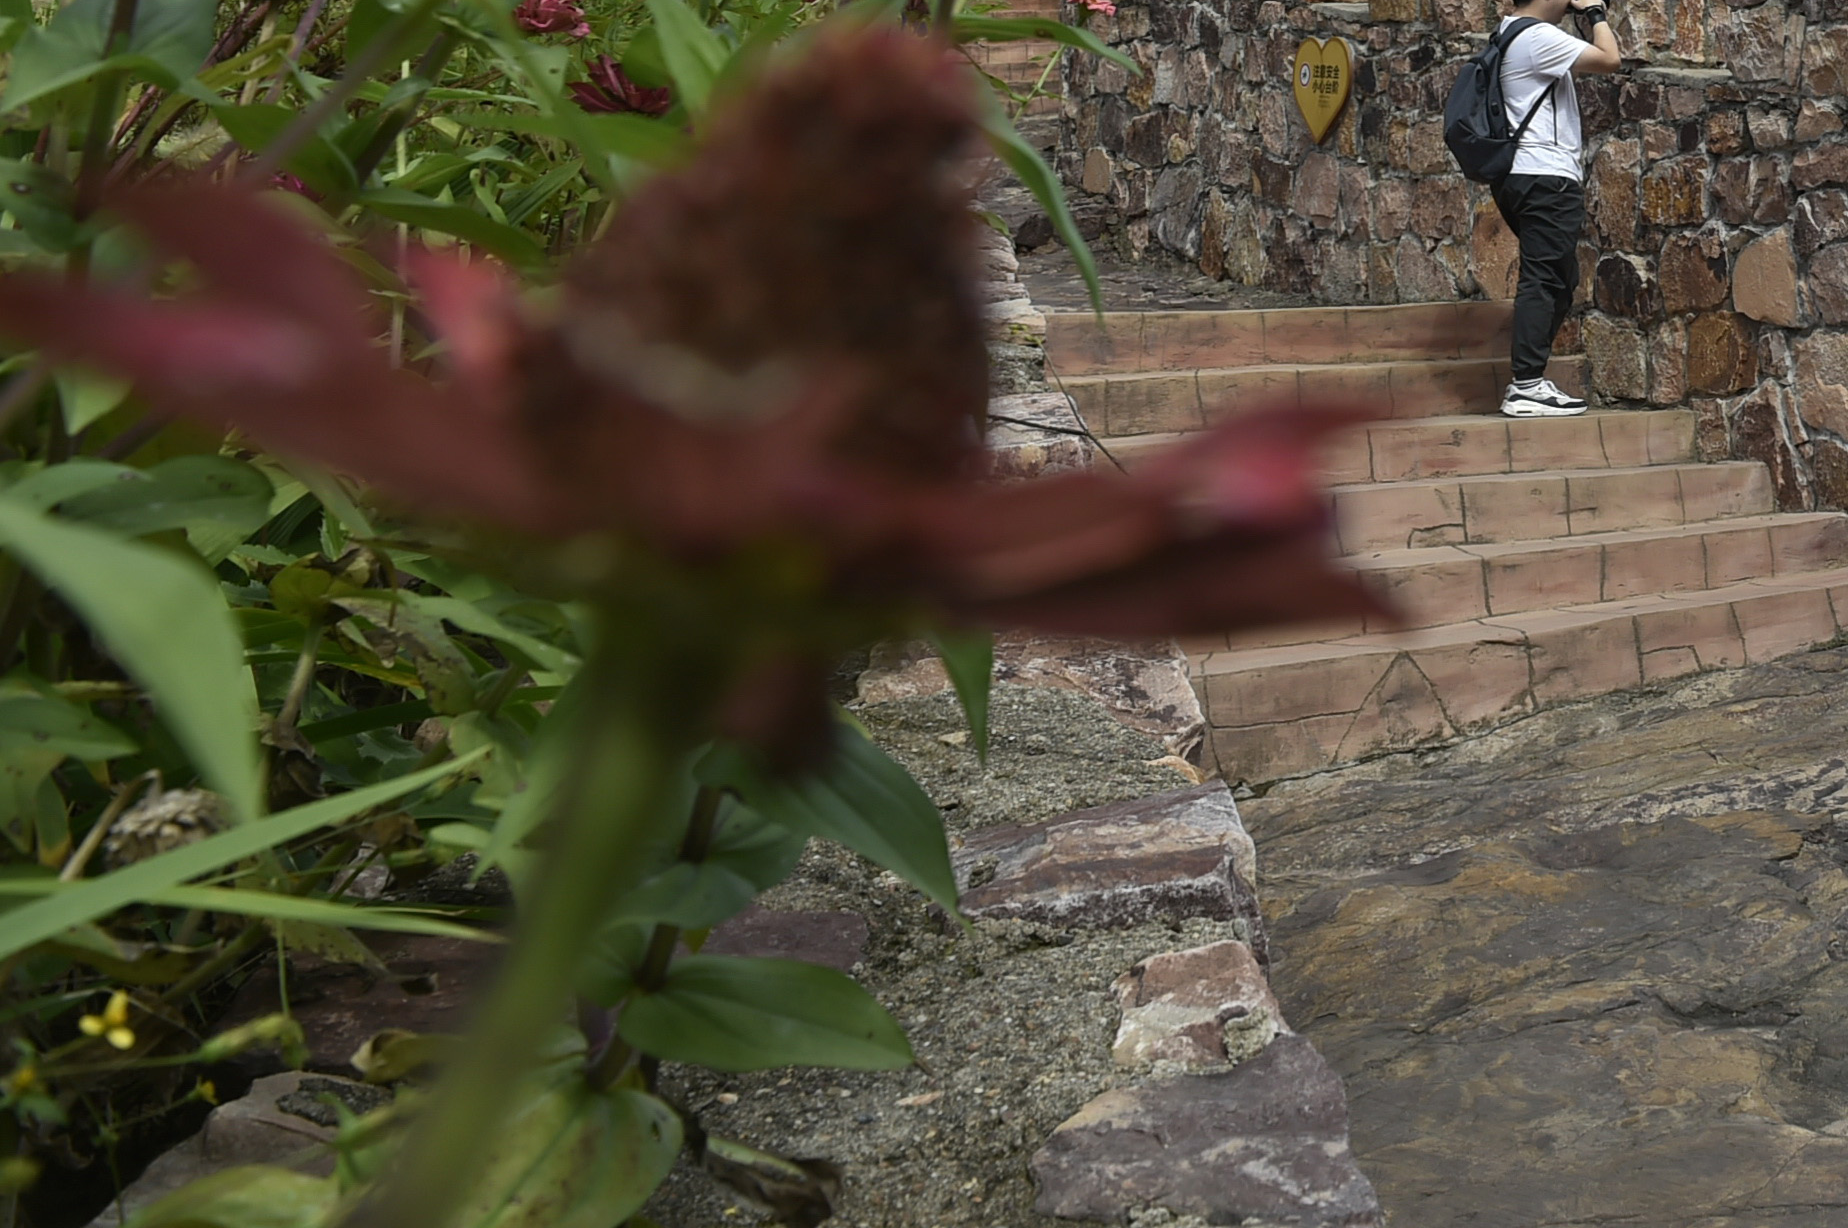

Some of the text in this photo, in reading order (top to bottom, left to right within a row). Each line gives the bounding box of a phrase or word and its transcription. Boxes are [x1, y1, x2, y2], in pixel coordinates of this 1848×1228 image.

[1313, 65, 1339, 79] 注意安全
[1312, 80, 1339, 94] 小心台阶
